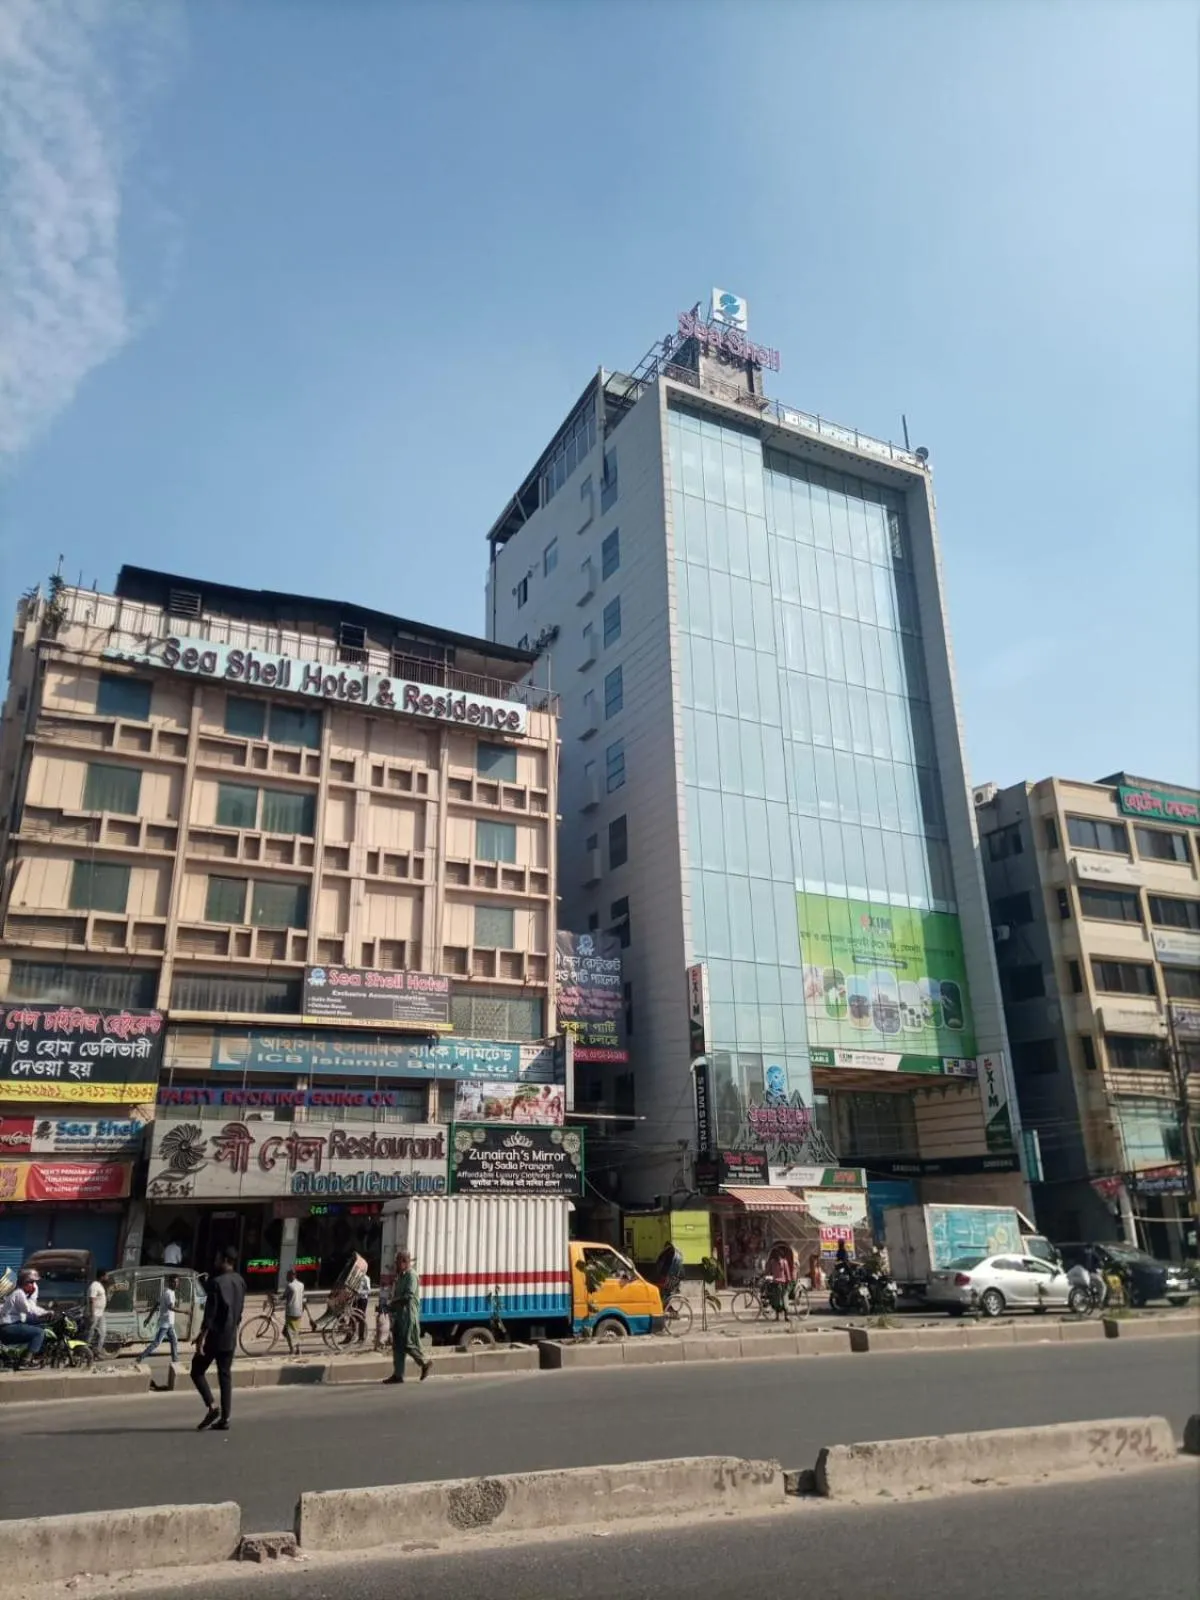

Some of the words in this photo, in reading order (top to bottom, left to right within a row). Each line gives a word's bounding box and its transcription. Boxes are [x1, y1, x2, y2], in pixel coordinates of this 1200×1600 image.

[679, 312, 724, 348] Sea
[726, 329, 781, 372] Shell
[162, 637, 218, 674] Sea
[224, 648, 291, 688] Shell
[303, 663, 368, 702] Hotel
[378, 678, 396, 709] &
[402, 683, 520, 731] Residence
[328, 968, 361, 986] Sea
[364, 972, 404, 989] Shell
[407, 975, 449, 993] Hotel
[5, 1008, 41, 1031] শেল
[43, 1006, 101, 1035] চাইনিজ
[16, 1039, 30, 1054] ও
[36, 1039, 75, 1058] হোম
[79, 1037, 153, 1058] ডেলিভারী
[11, 1059, 64, 1077] দেওয়া
[68, 1060, 94, 1080] হয়
[257, 1053, 303, 1064] ICB
[312, 1055, 400, 1069] Islamic
[407, 1060, 466, 1071] Bank
[473, 1063, 515, 1073] Ltd.
[984, 1058, 1000, 1107] EXIM
[160, 1088, 215, 1105] PARTY
[222, 1089, 306, 1106] BOOKING
[369, 1091, 396, 1106] ON
[697, 1076, 708, 1152] SAMSUNG
[56, 1120, 92, 1136] Sea
[96, 1120, 141, 1136] Shell
[210, 1122, 256, 1174] সী
[258, 1130, 328, 1174] শেল
[329, 1128, 446, 1160] Restaurant
[469, 1148, 530, 1161] Zunairah's
[532, 1150, 566, 1162] Mirror
[481, 1161, 494, 1172] By
[494, 1161, 519, 1170] Sadia
[291, 1170, 365, 1194] Global
[366, 1170, 446, 1194] Cuisine
[820, 1227, 851, 1239] TO-LET
